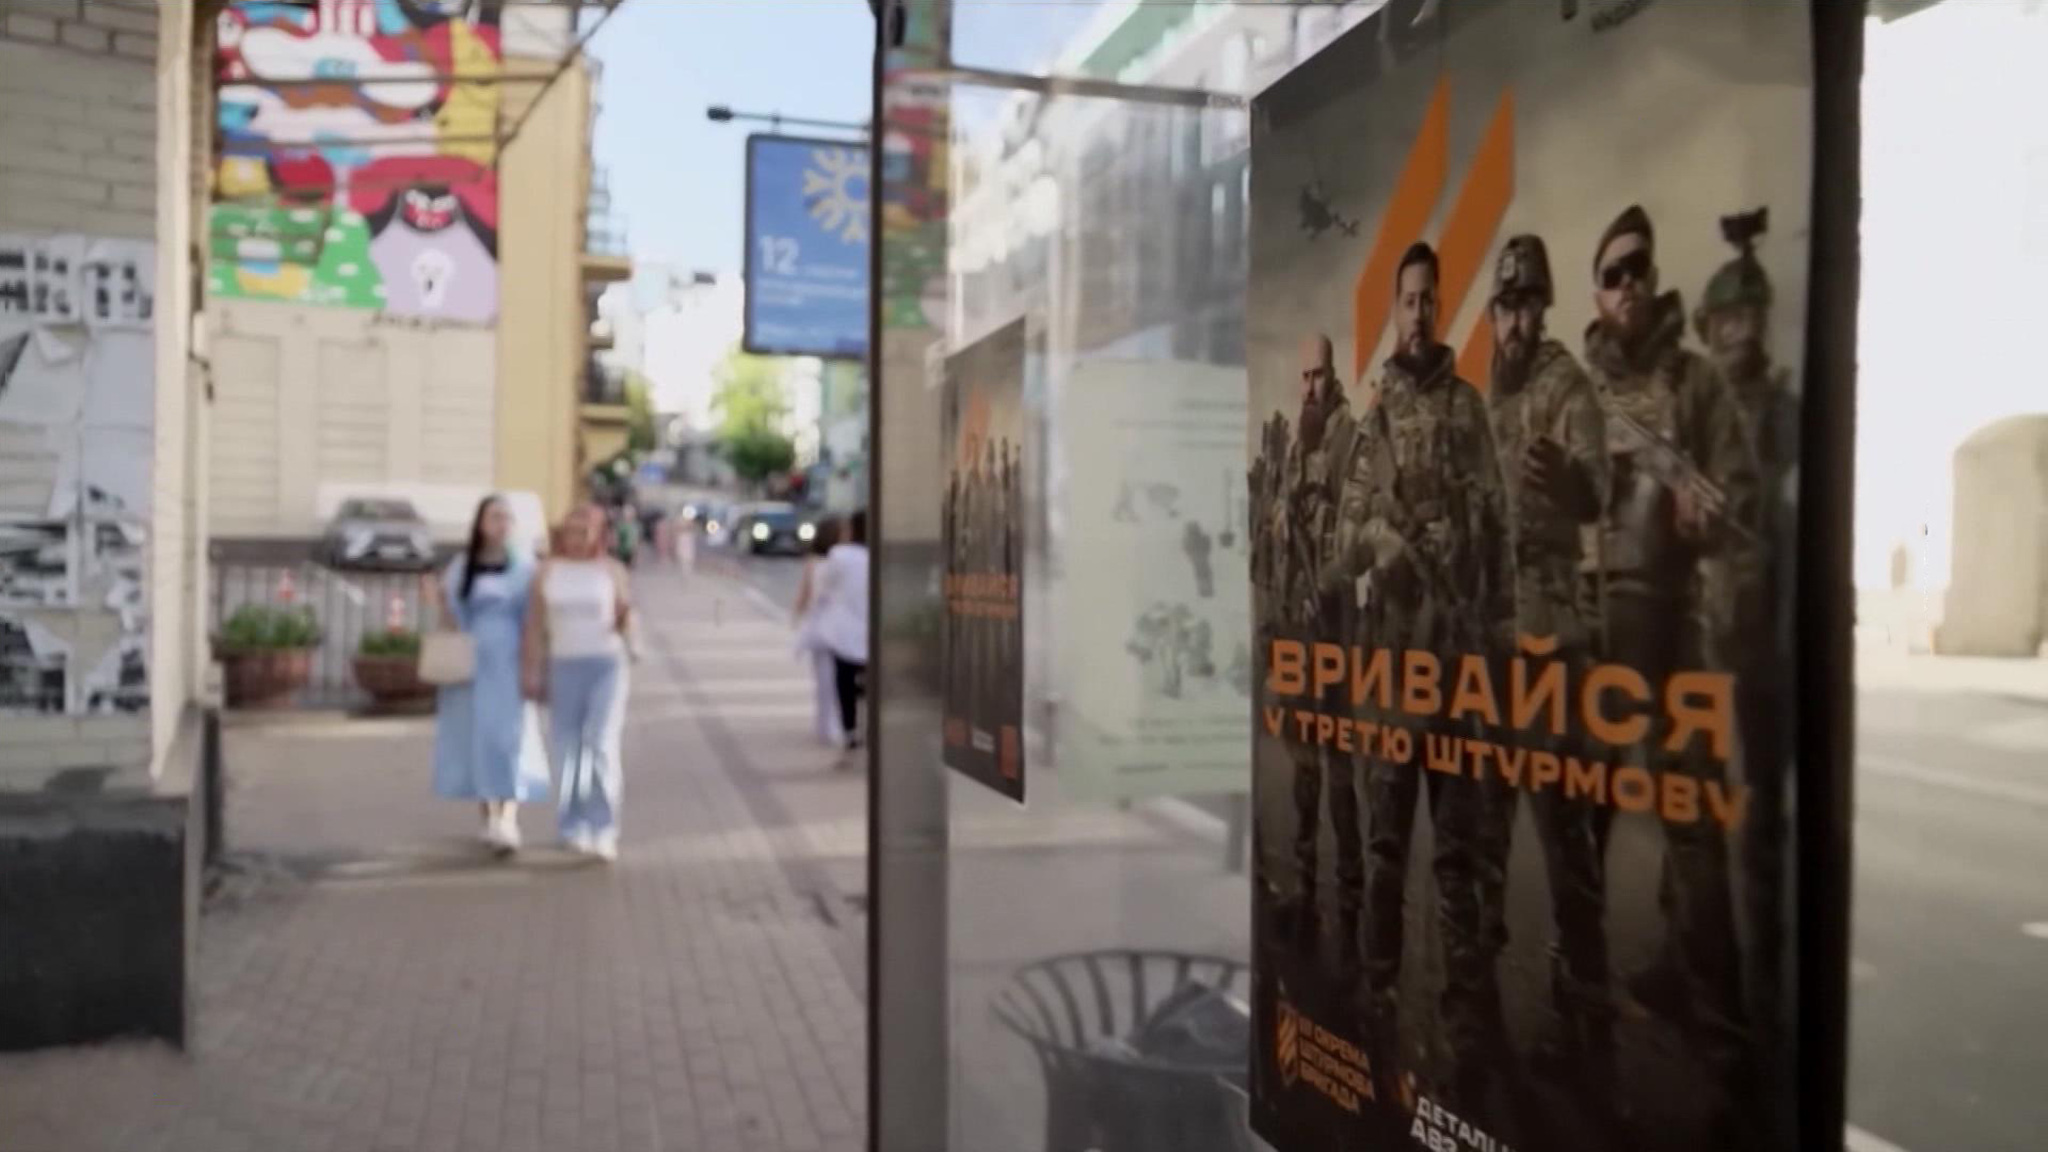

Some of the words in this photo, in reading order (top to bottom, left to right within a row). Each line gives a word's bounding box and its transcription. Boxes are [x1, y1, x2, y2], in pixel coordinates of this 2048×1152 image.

[761, 235, 799, 275] 12
[1268, 632, 1735, 760] ВРИВАЙСЯ
[1296, 711, 1414, 765] ТРЕТЮ
[1425, 731, 1752, 831] ШТУРМОВУ
